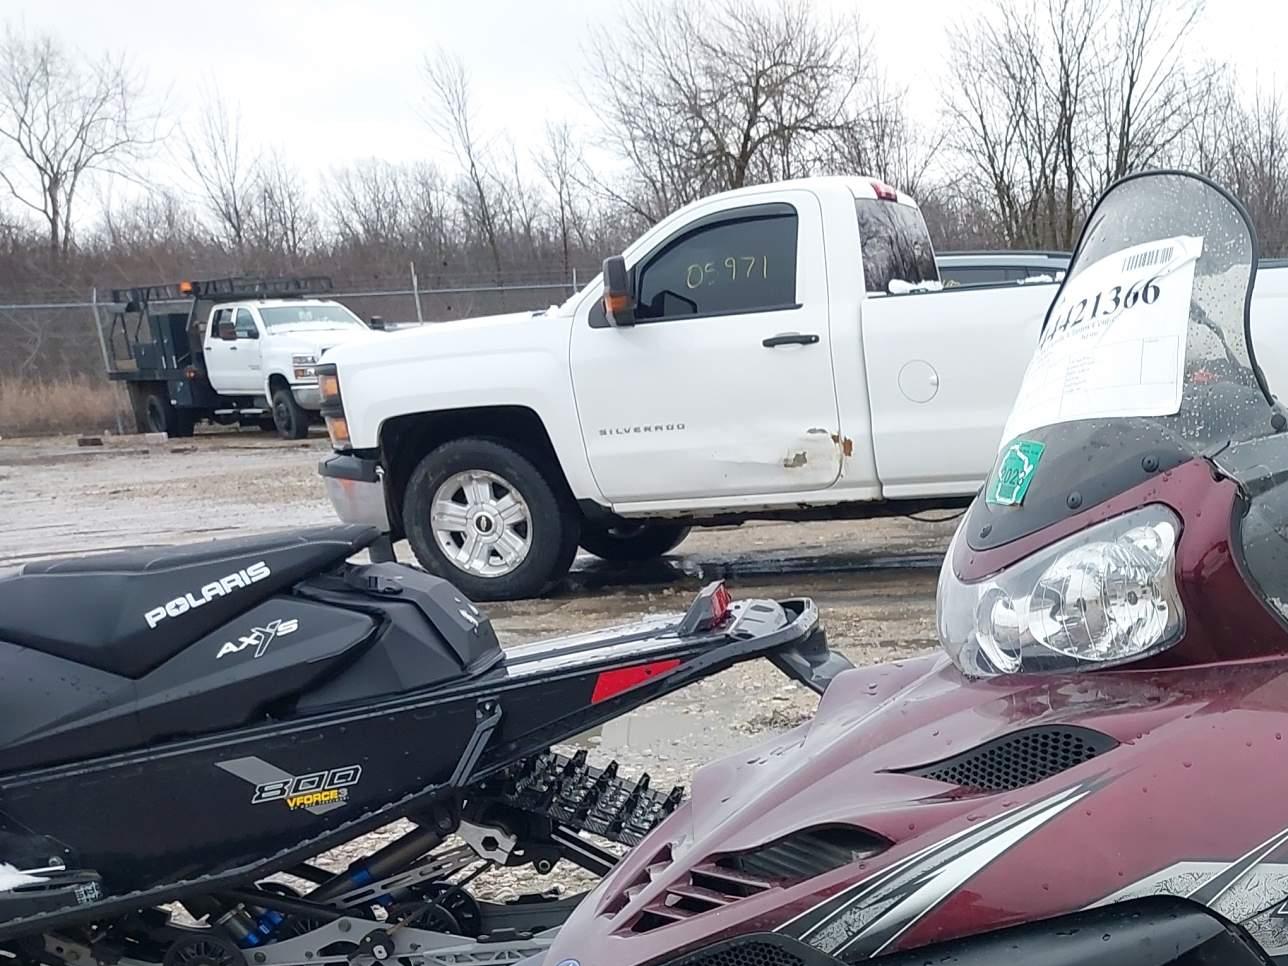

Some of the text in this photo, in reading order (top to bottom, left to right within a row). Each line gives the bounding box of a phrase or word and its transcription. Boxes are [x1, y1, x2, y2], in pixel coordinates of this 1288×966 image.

[599, 423, 686, 436] SILVERADO
[144, 561, 271, 629] POLARIS
[216, 618, 299, 659] AXYS
[251, 764, 363, 805] 800
